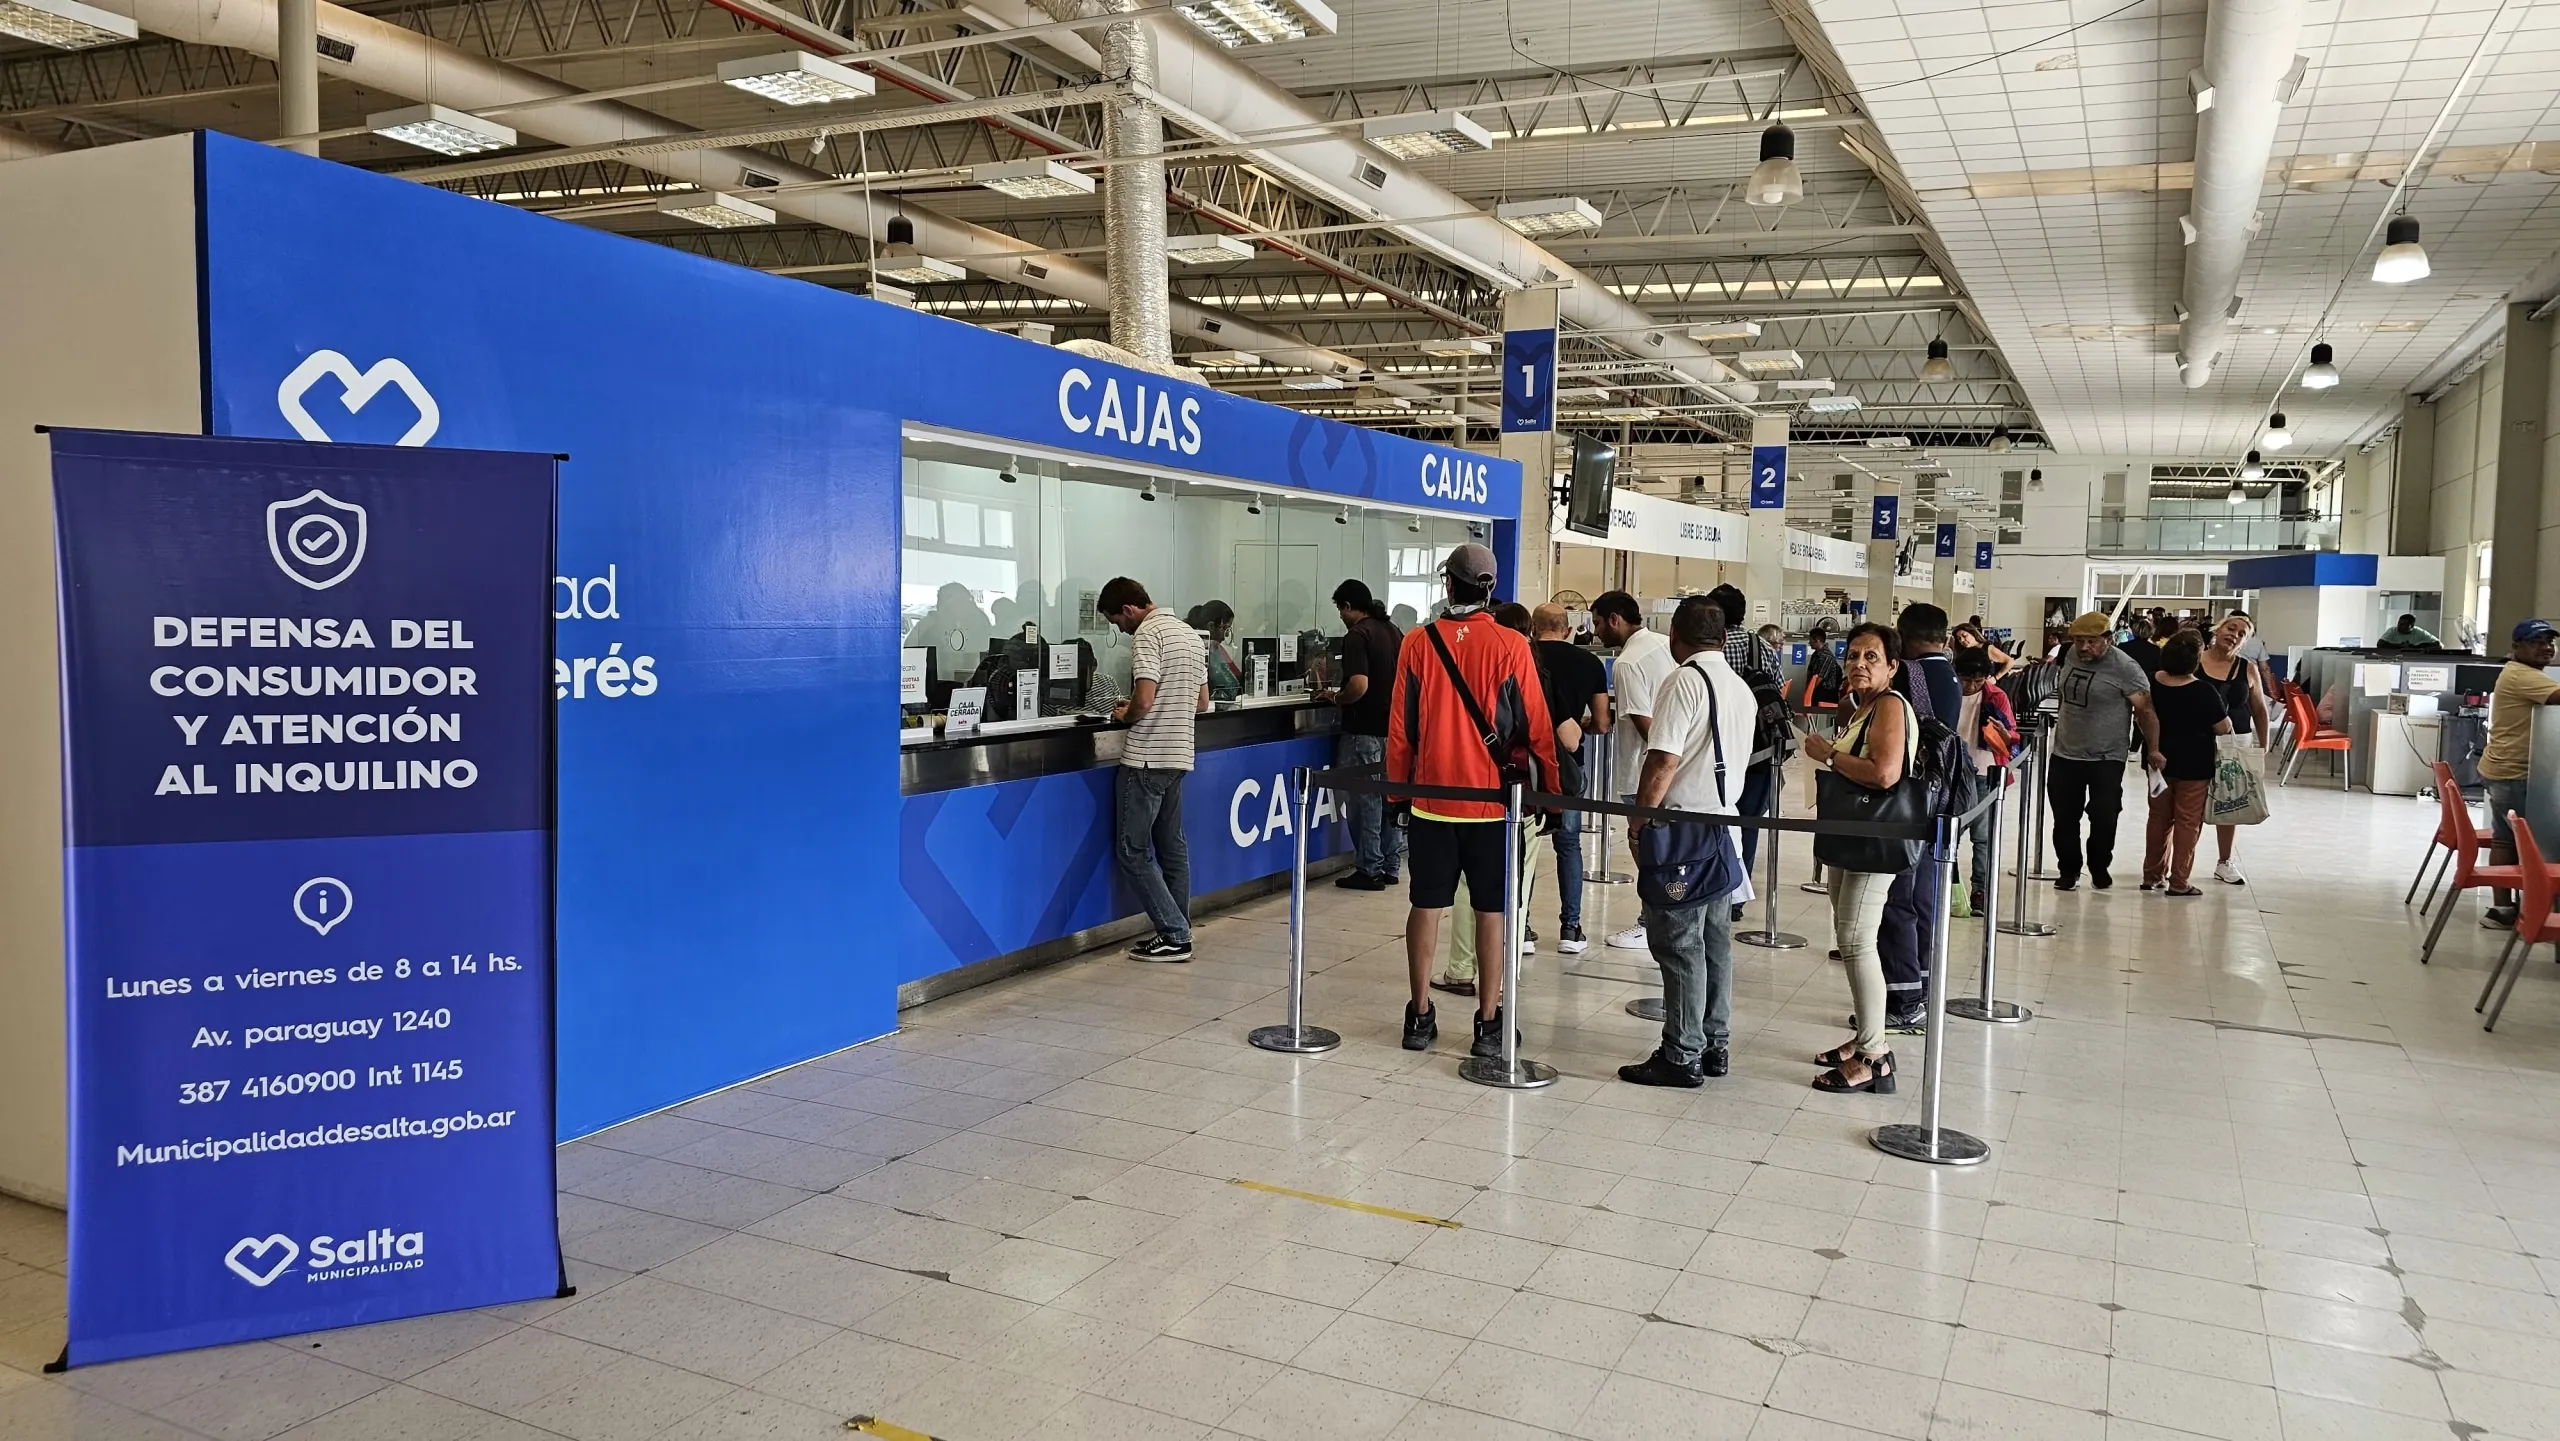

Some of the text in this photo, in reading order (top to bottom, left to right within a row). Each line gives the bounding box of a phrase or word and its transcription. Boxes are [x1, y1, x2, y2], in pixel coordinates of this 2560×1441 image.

[1522, 364, 1535, 398] 1
[1058, 367, 1202, 456] CAJAS
[1421, 453, 1488, 505] CAJAS
[1760, 467, 1776, 488] 2
[1617, 509, 1637, 529] PAGO
[1680, 521, 1694, 539] LIBRE
[1695, 524, 1703, 541] DE
[1879, 510, 1891, 525] 3
[1941, 535, 1951, 547] 4
[1980, 550, 1988, 561] 5
[153, 616, 474, 649] DEFENSA DEL
[1795, 650, 1802, 659] 5
[149, 665, 479, 697] CONSUMIDOR
[950, 708, 980, 717] CERRADA
[959, 701, 975, 709] CAJA
[172, 706, 461, 746] Y ATENCIÓN
[154, 759, 478, 796] AL INQUILINO
[1230, 765, 1347, 848] CAA
[107, 952, 523, 998] Lunes a viernes de 8 a 14 hs.
[191, 1008, 451, 1049] Av. paraguay 1240
[178, 1059, 463, 1105] 387 4160900 Int 1145
[117, 1107, 516, 1167] Municipalidaddesalta.gob.ar
[308, 1227, 424, 1270] Salta
[307, 1258, 424, 1283] MUNICIPALIDAD
